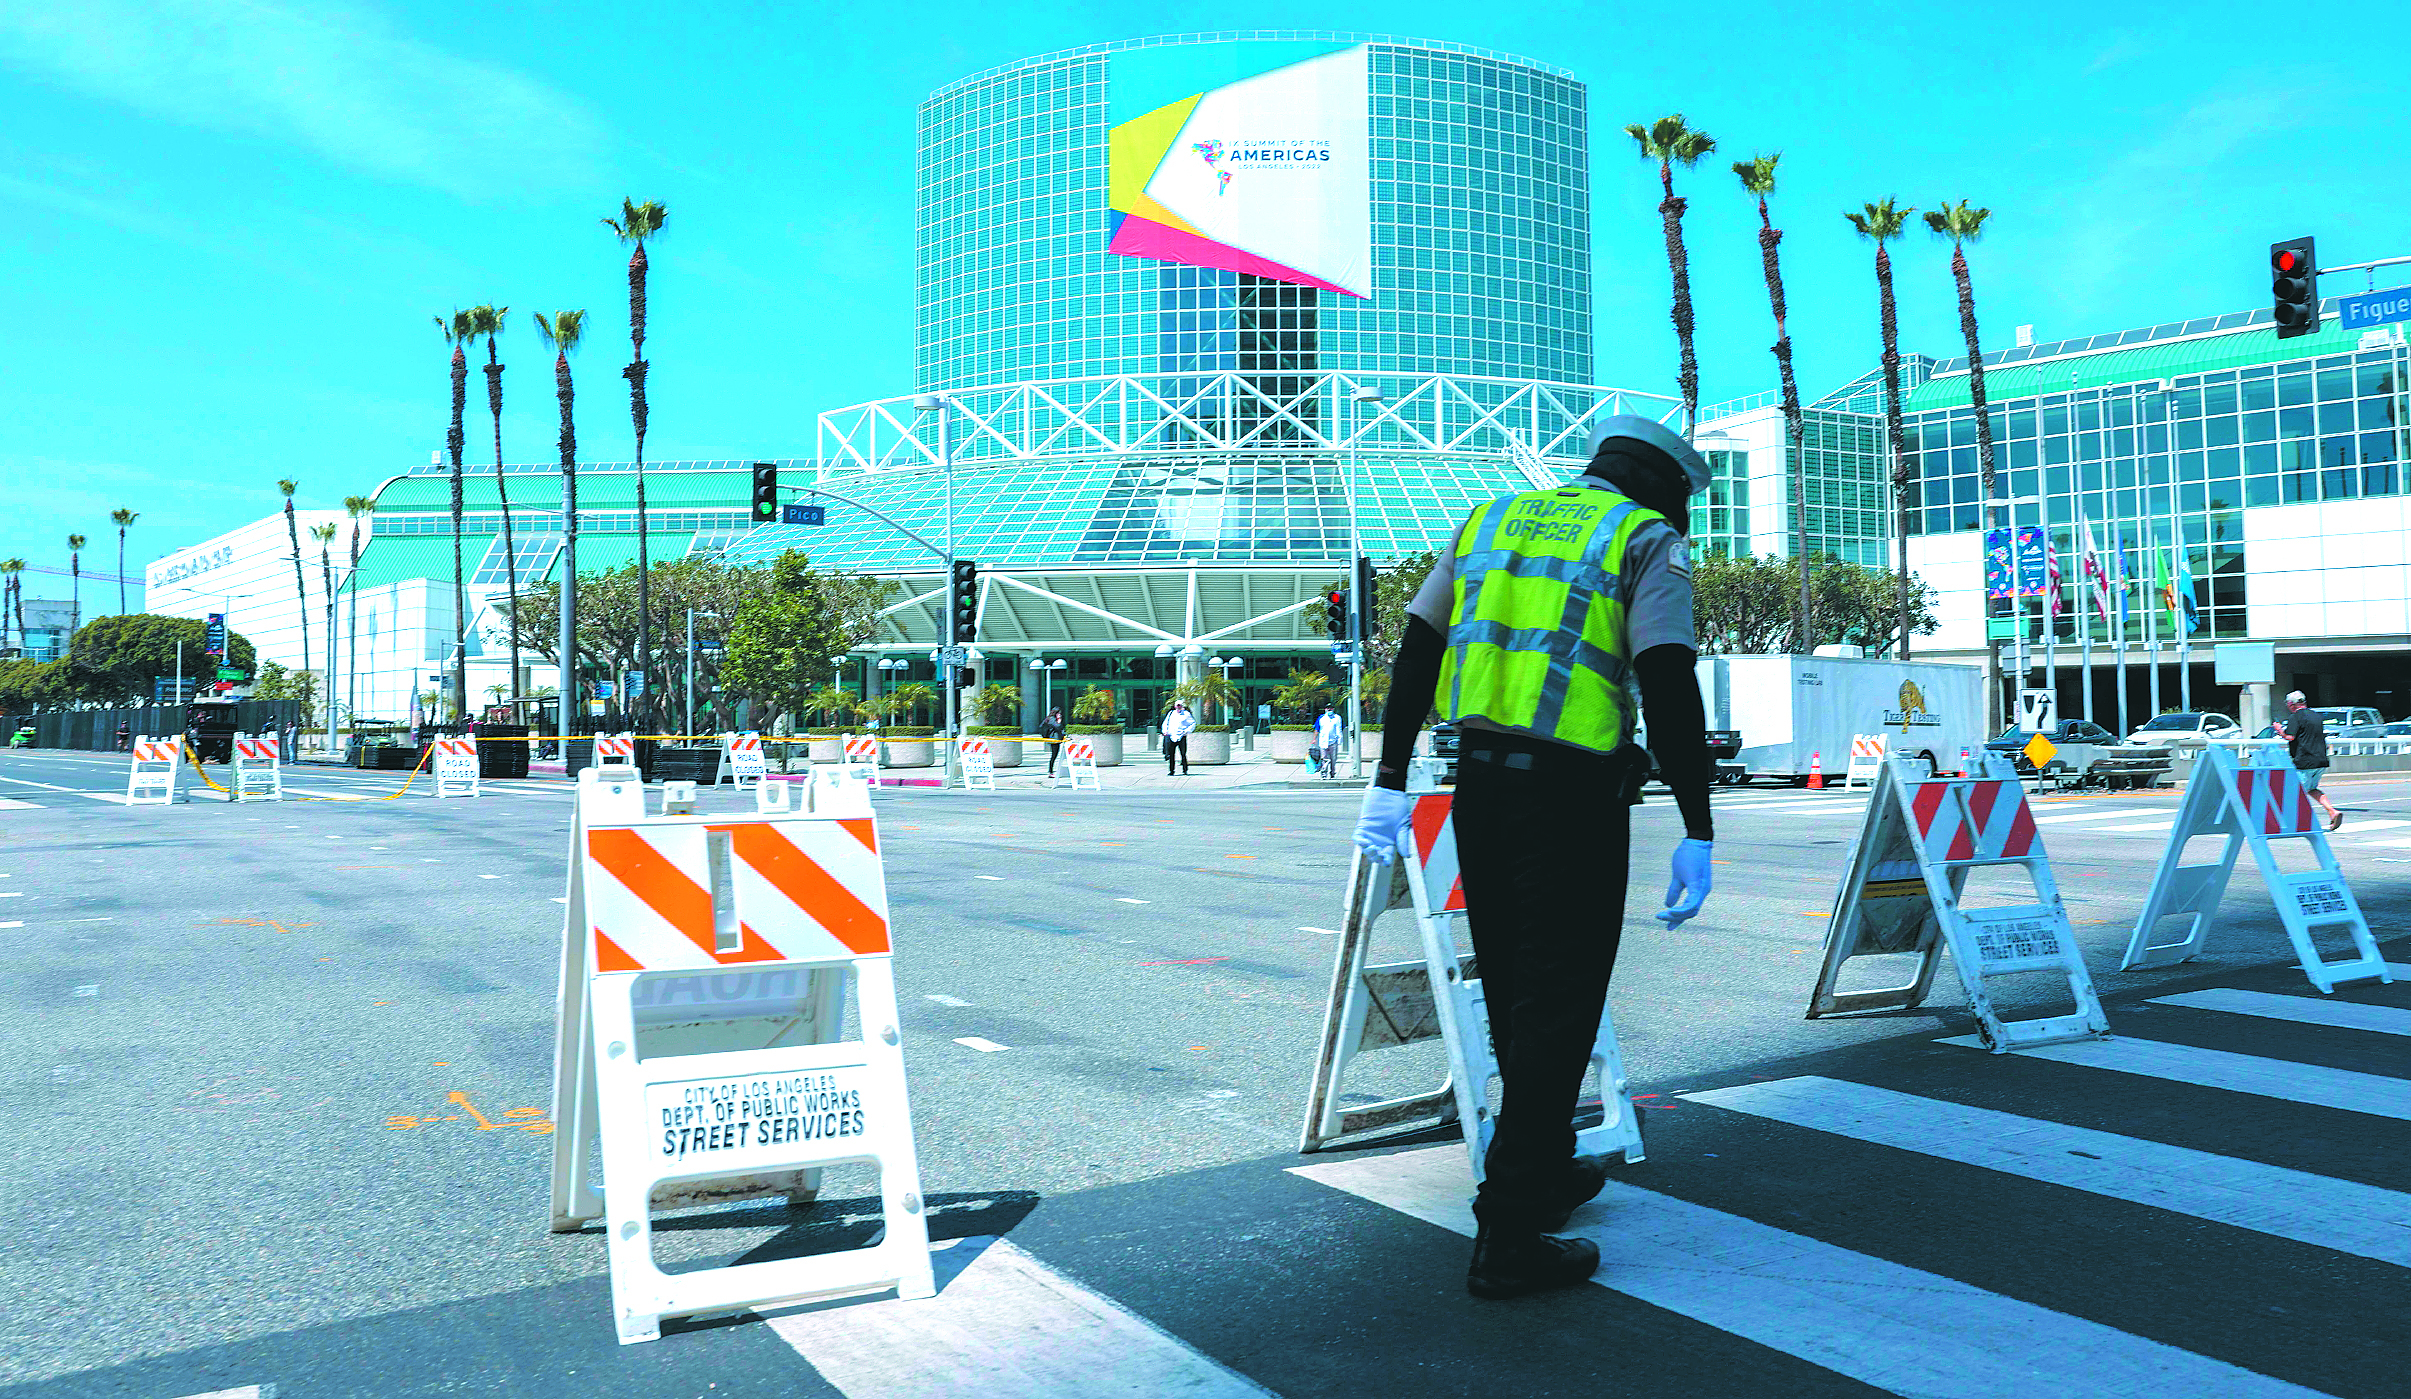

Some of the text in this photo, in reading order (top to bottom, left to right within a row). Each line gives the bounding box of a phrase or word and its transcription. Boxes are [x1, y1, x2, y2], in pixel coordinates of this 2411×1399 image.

[1230, 149, 1330, 162] AMERICAS
[2349, 297, 2411, 322] Figue
[789, 508, 819, 521] Pico
[1517, 499, 1598, 521] TRAFFIC
[445, 759, 471, 768] ROAD
[736, 754, 758, 762] ROAD
[441, 770, 477, 779] CLOSED
[1980, 944, 2014, 960] STREET
[685, 1075, 836, 1104] CITY OF LOS ANGELES
[662, 1090, 860, 1128] DEPT. OF PUBLIC WORKS
[662, 1110, 865, 1156] STREET SERVICES
